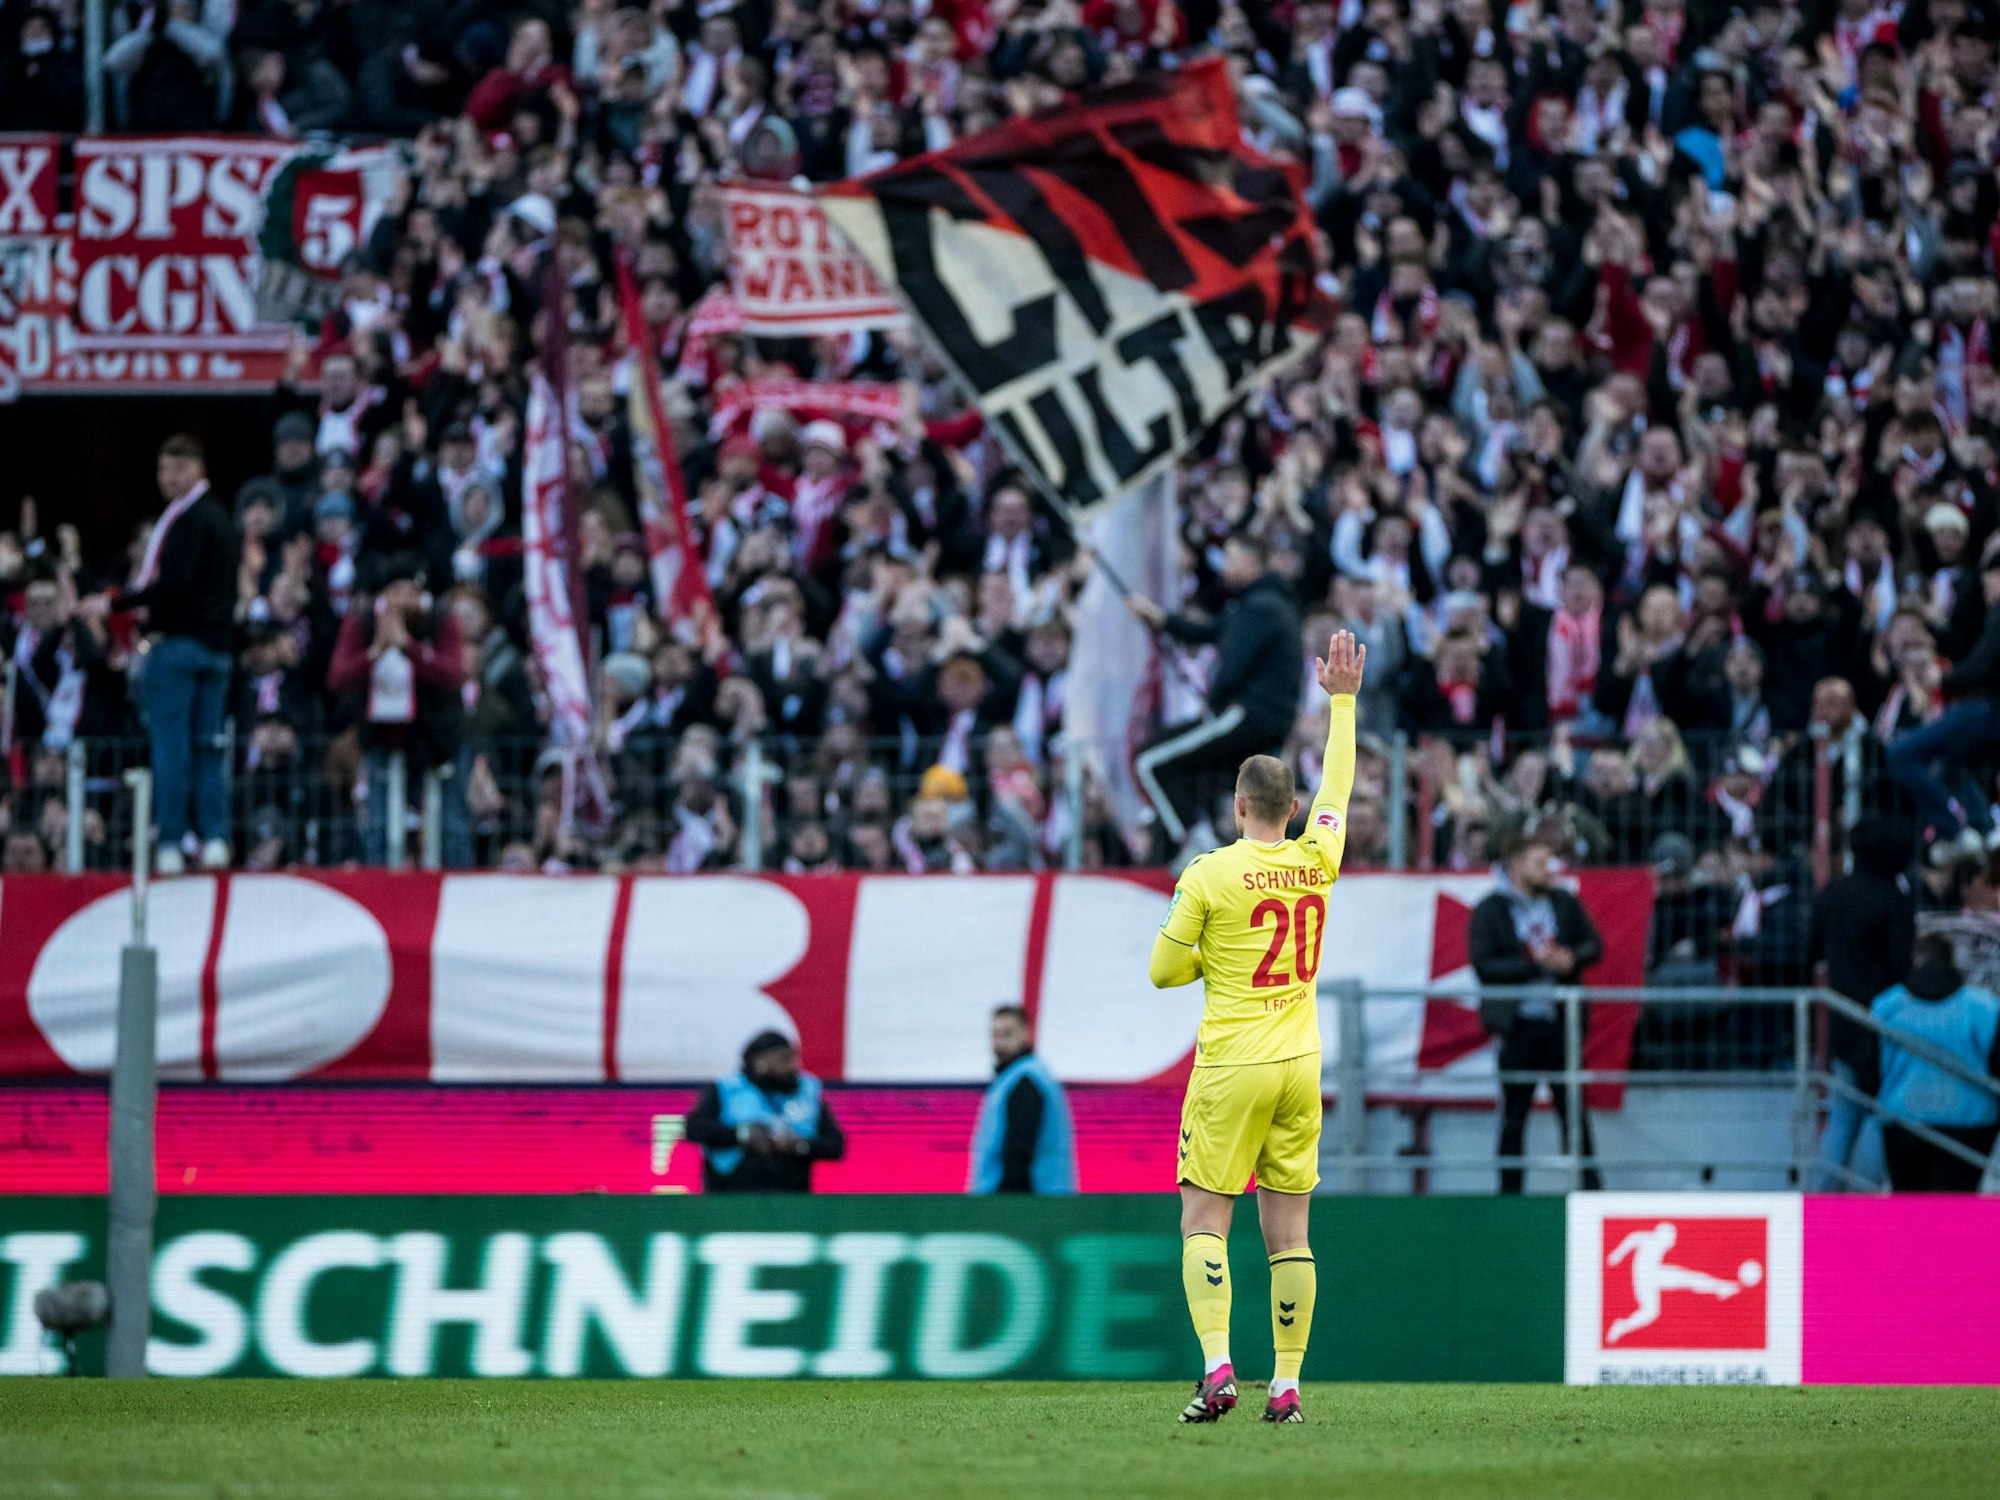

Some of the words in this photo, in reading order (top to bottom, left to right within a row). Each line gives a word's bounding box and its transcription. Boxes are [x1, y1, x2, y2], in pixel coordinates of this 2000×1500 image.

[78, 153, 264, 240] SPS
[301, 193, 357, 268] 5
[79, 253, 262, 336] CGN
[1243, 865, 1327, 891] SCHWÄBE
[1250, 894, 1326, 989] 20
